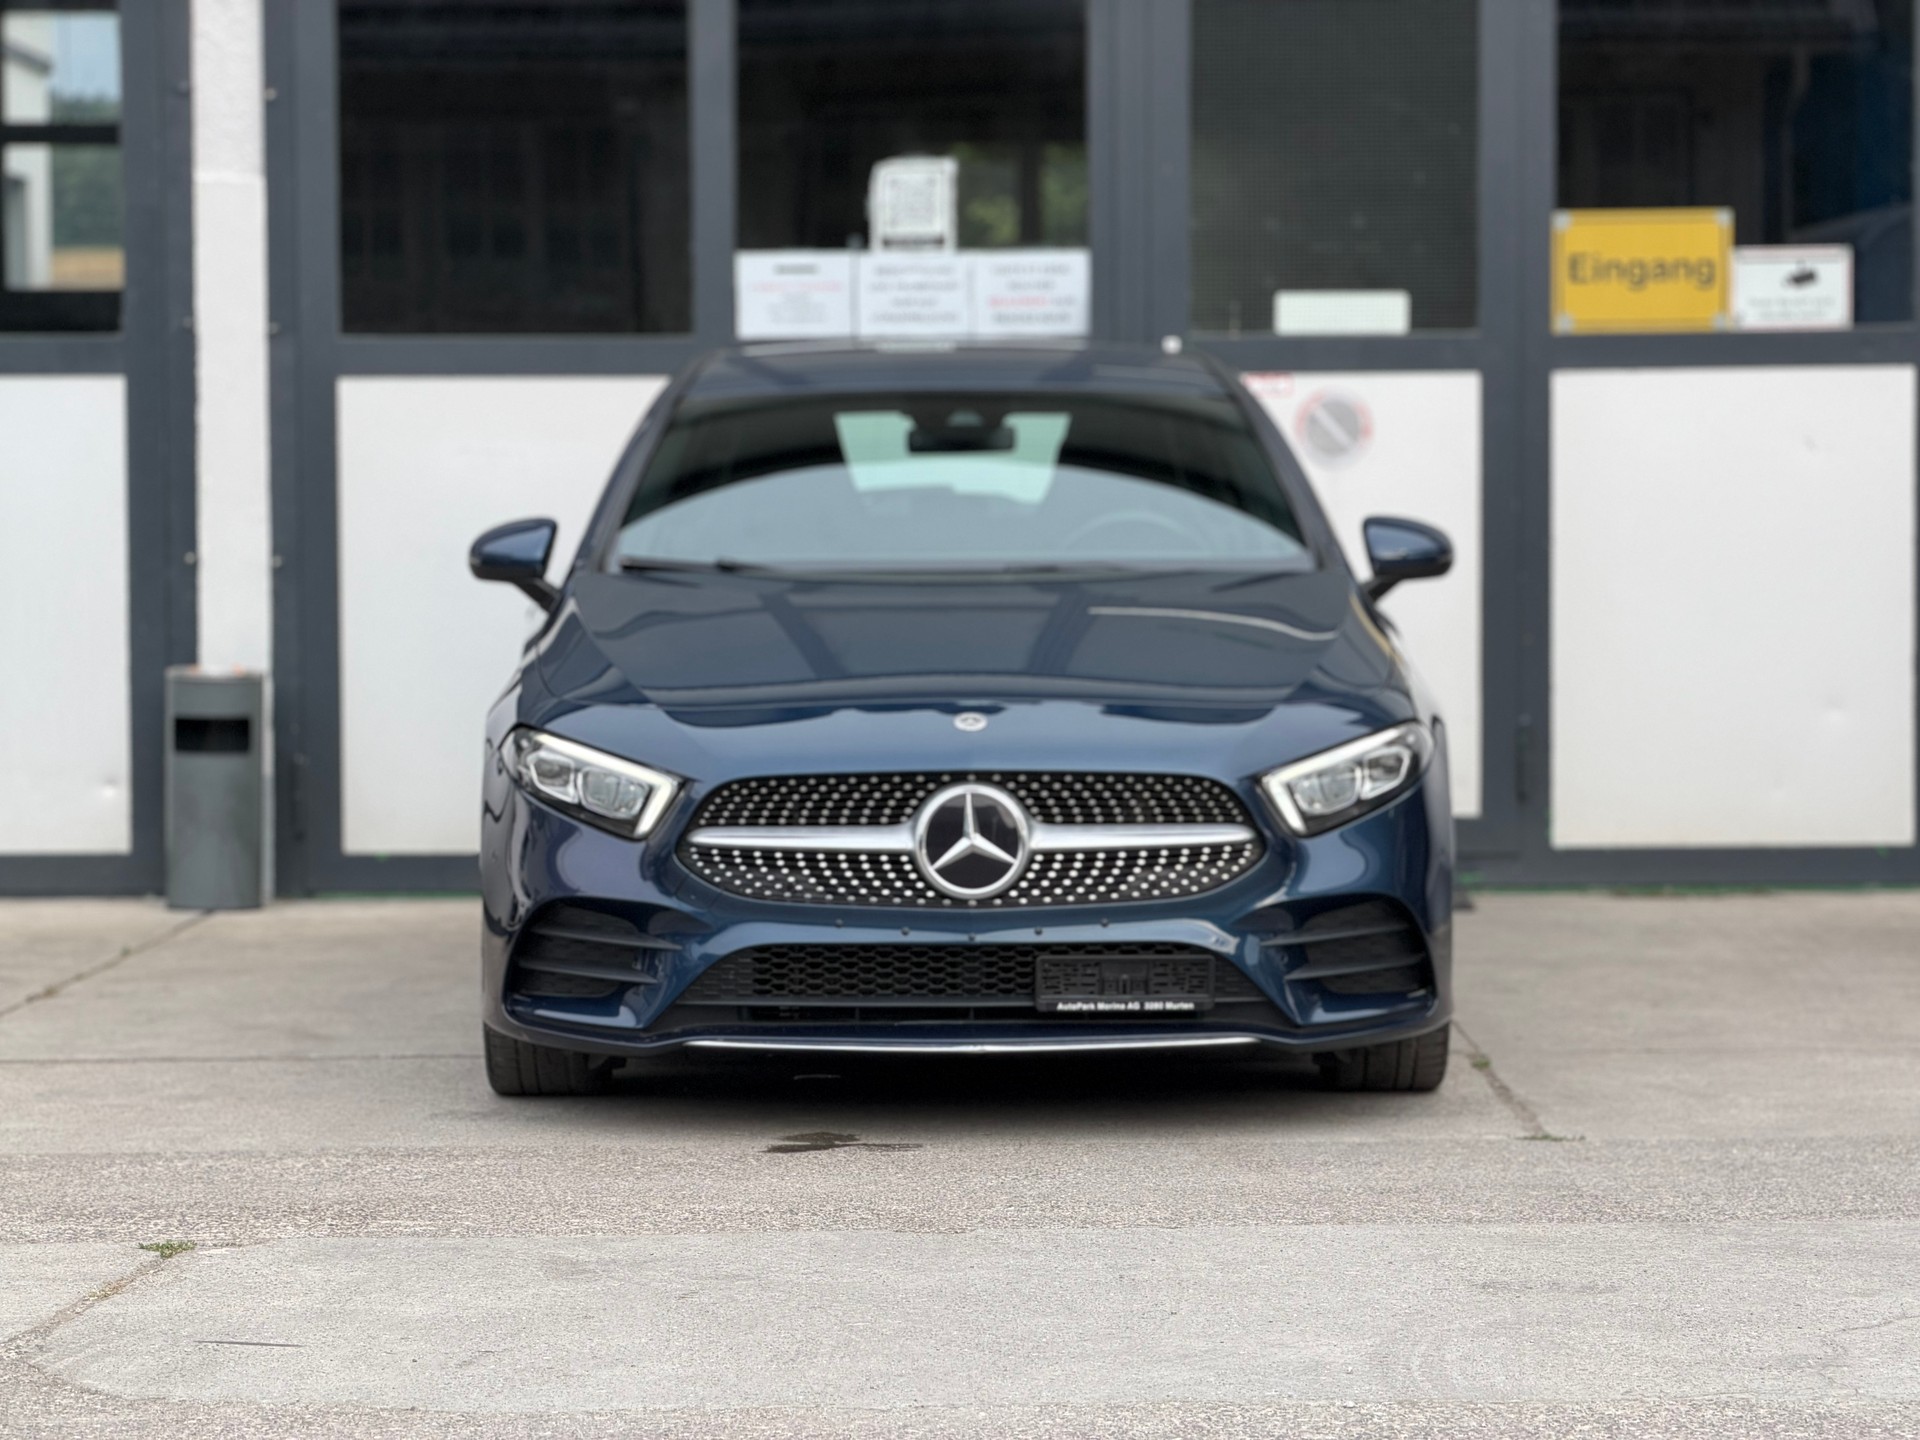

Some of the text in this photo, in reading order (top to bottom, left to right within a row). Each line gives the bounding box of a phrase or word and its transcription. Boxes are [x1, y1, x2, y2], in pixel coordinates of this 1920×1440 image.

[1568, 252, 1716, 292] Eingang
[1056, 1001, 1095, 1011] AutoPark
[1127, 1001, 1141, 1011] AG
